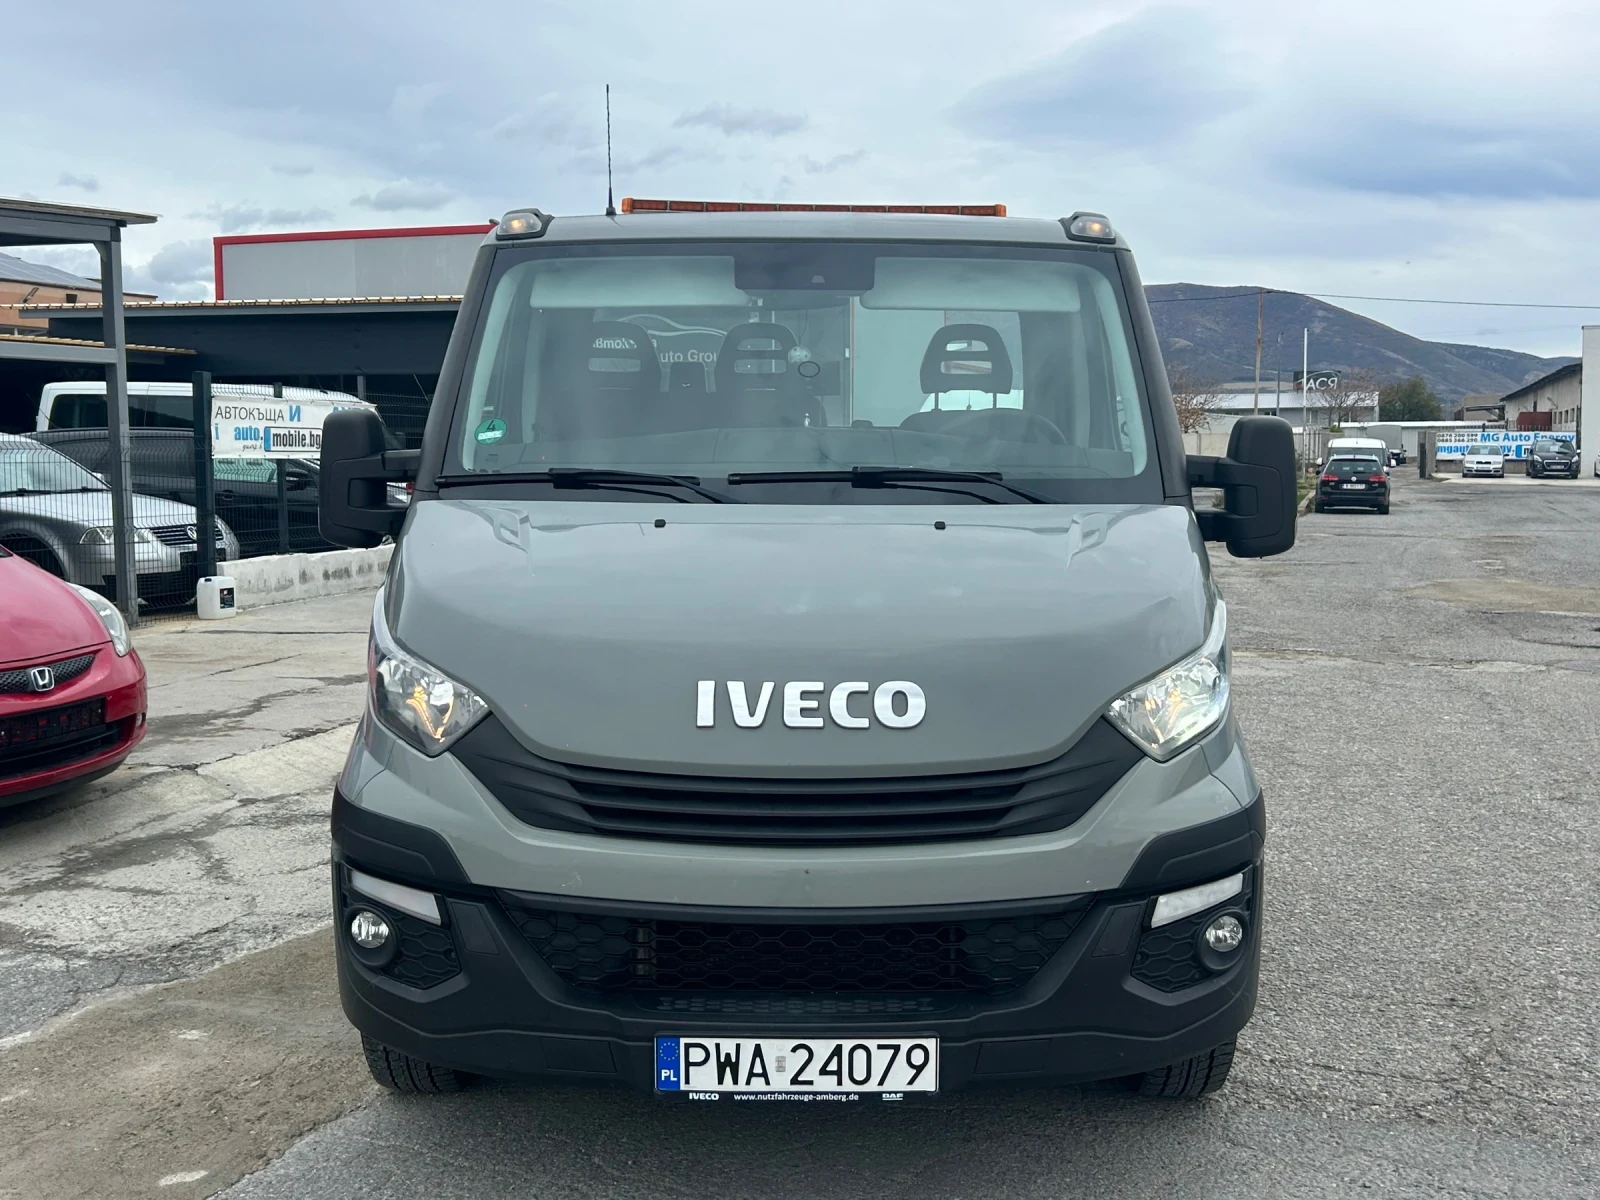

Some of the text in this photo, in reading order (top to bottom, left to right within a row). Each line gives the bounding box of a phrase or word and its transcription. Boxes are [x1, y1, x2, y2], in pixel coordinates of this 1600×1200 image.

[660, 350, 717, 362] uto Gro
[215, 406, 285, 423] АВТОКЪЩА
[486, 420, 496, 431] 4
[272, 430, 321, 449] mobile.bg
[1480, 433, 1500, 442] MG
[1503, 433, 1530, 442] Auto
[696, 680, 927, 729] IVECO
[683, 1042, 930, 1087] PWA 24079
[661, 1069, 678, 1081] PL
[689, 1092, 720, 1101] IVECO
[734, 1091, 859, 1102] www.nutzfahrzeuge-amberg.de
